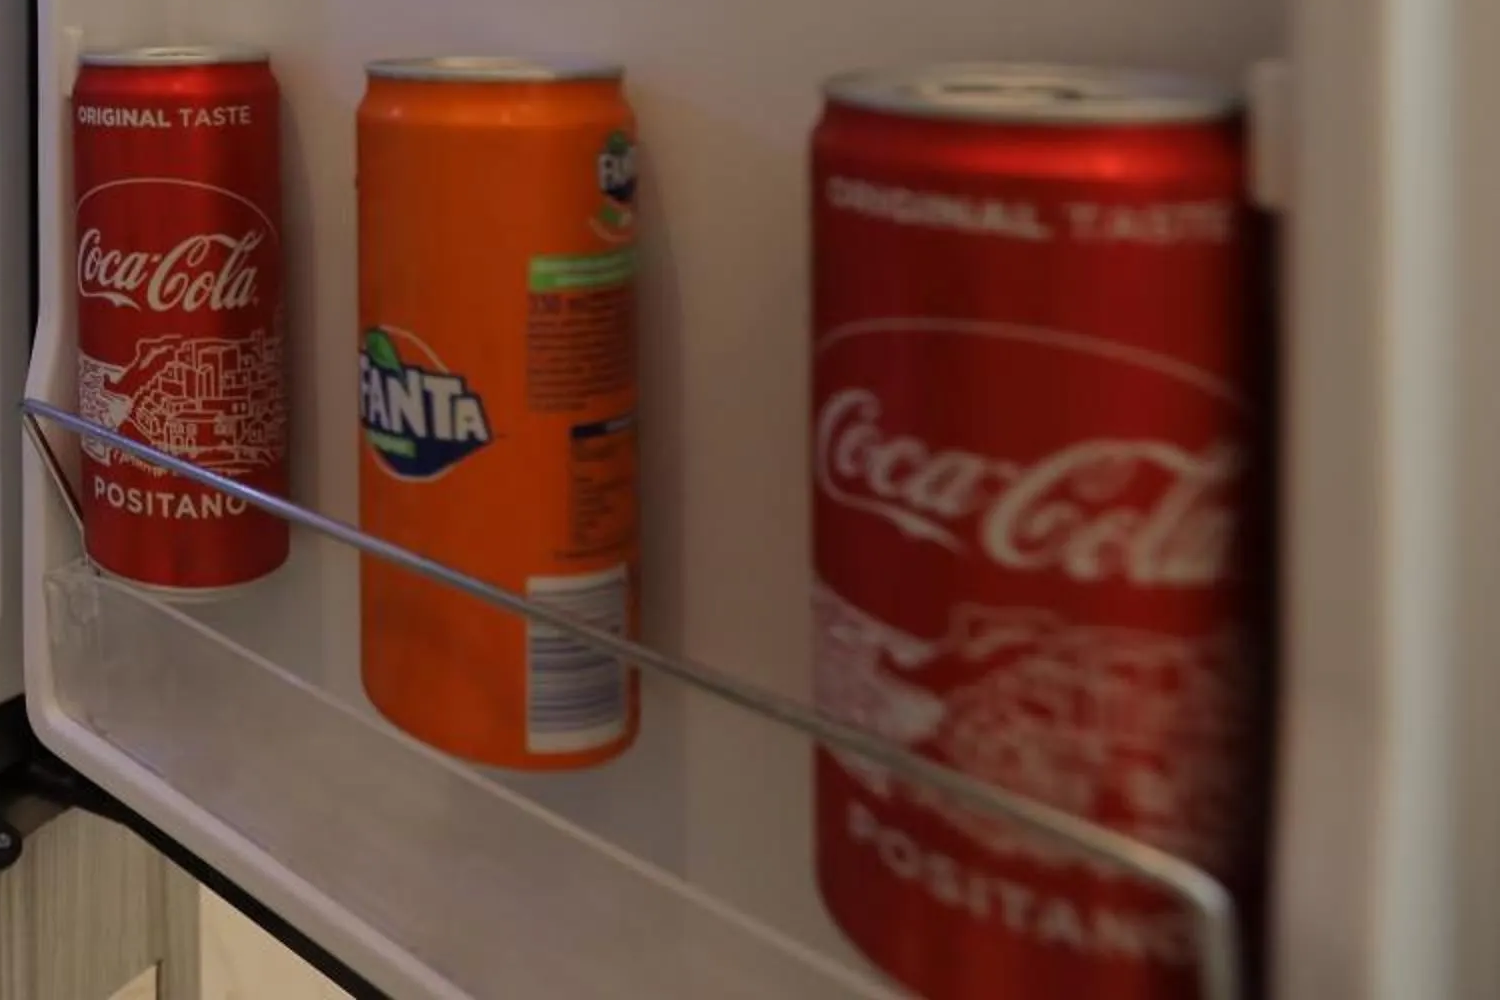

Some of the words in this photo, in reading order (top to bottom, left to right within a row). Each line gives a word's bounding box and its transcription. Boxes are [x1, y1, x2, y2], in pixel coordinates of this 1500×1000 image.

[78, 105, 172, 128] ORIGINAL
[180, 105, 252, 127] TASTE
[78, 228, 268, 313] Coca-Cola
[93, 474, 248, 519] POSITANO
